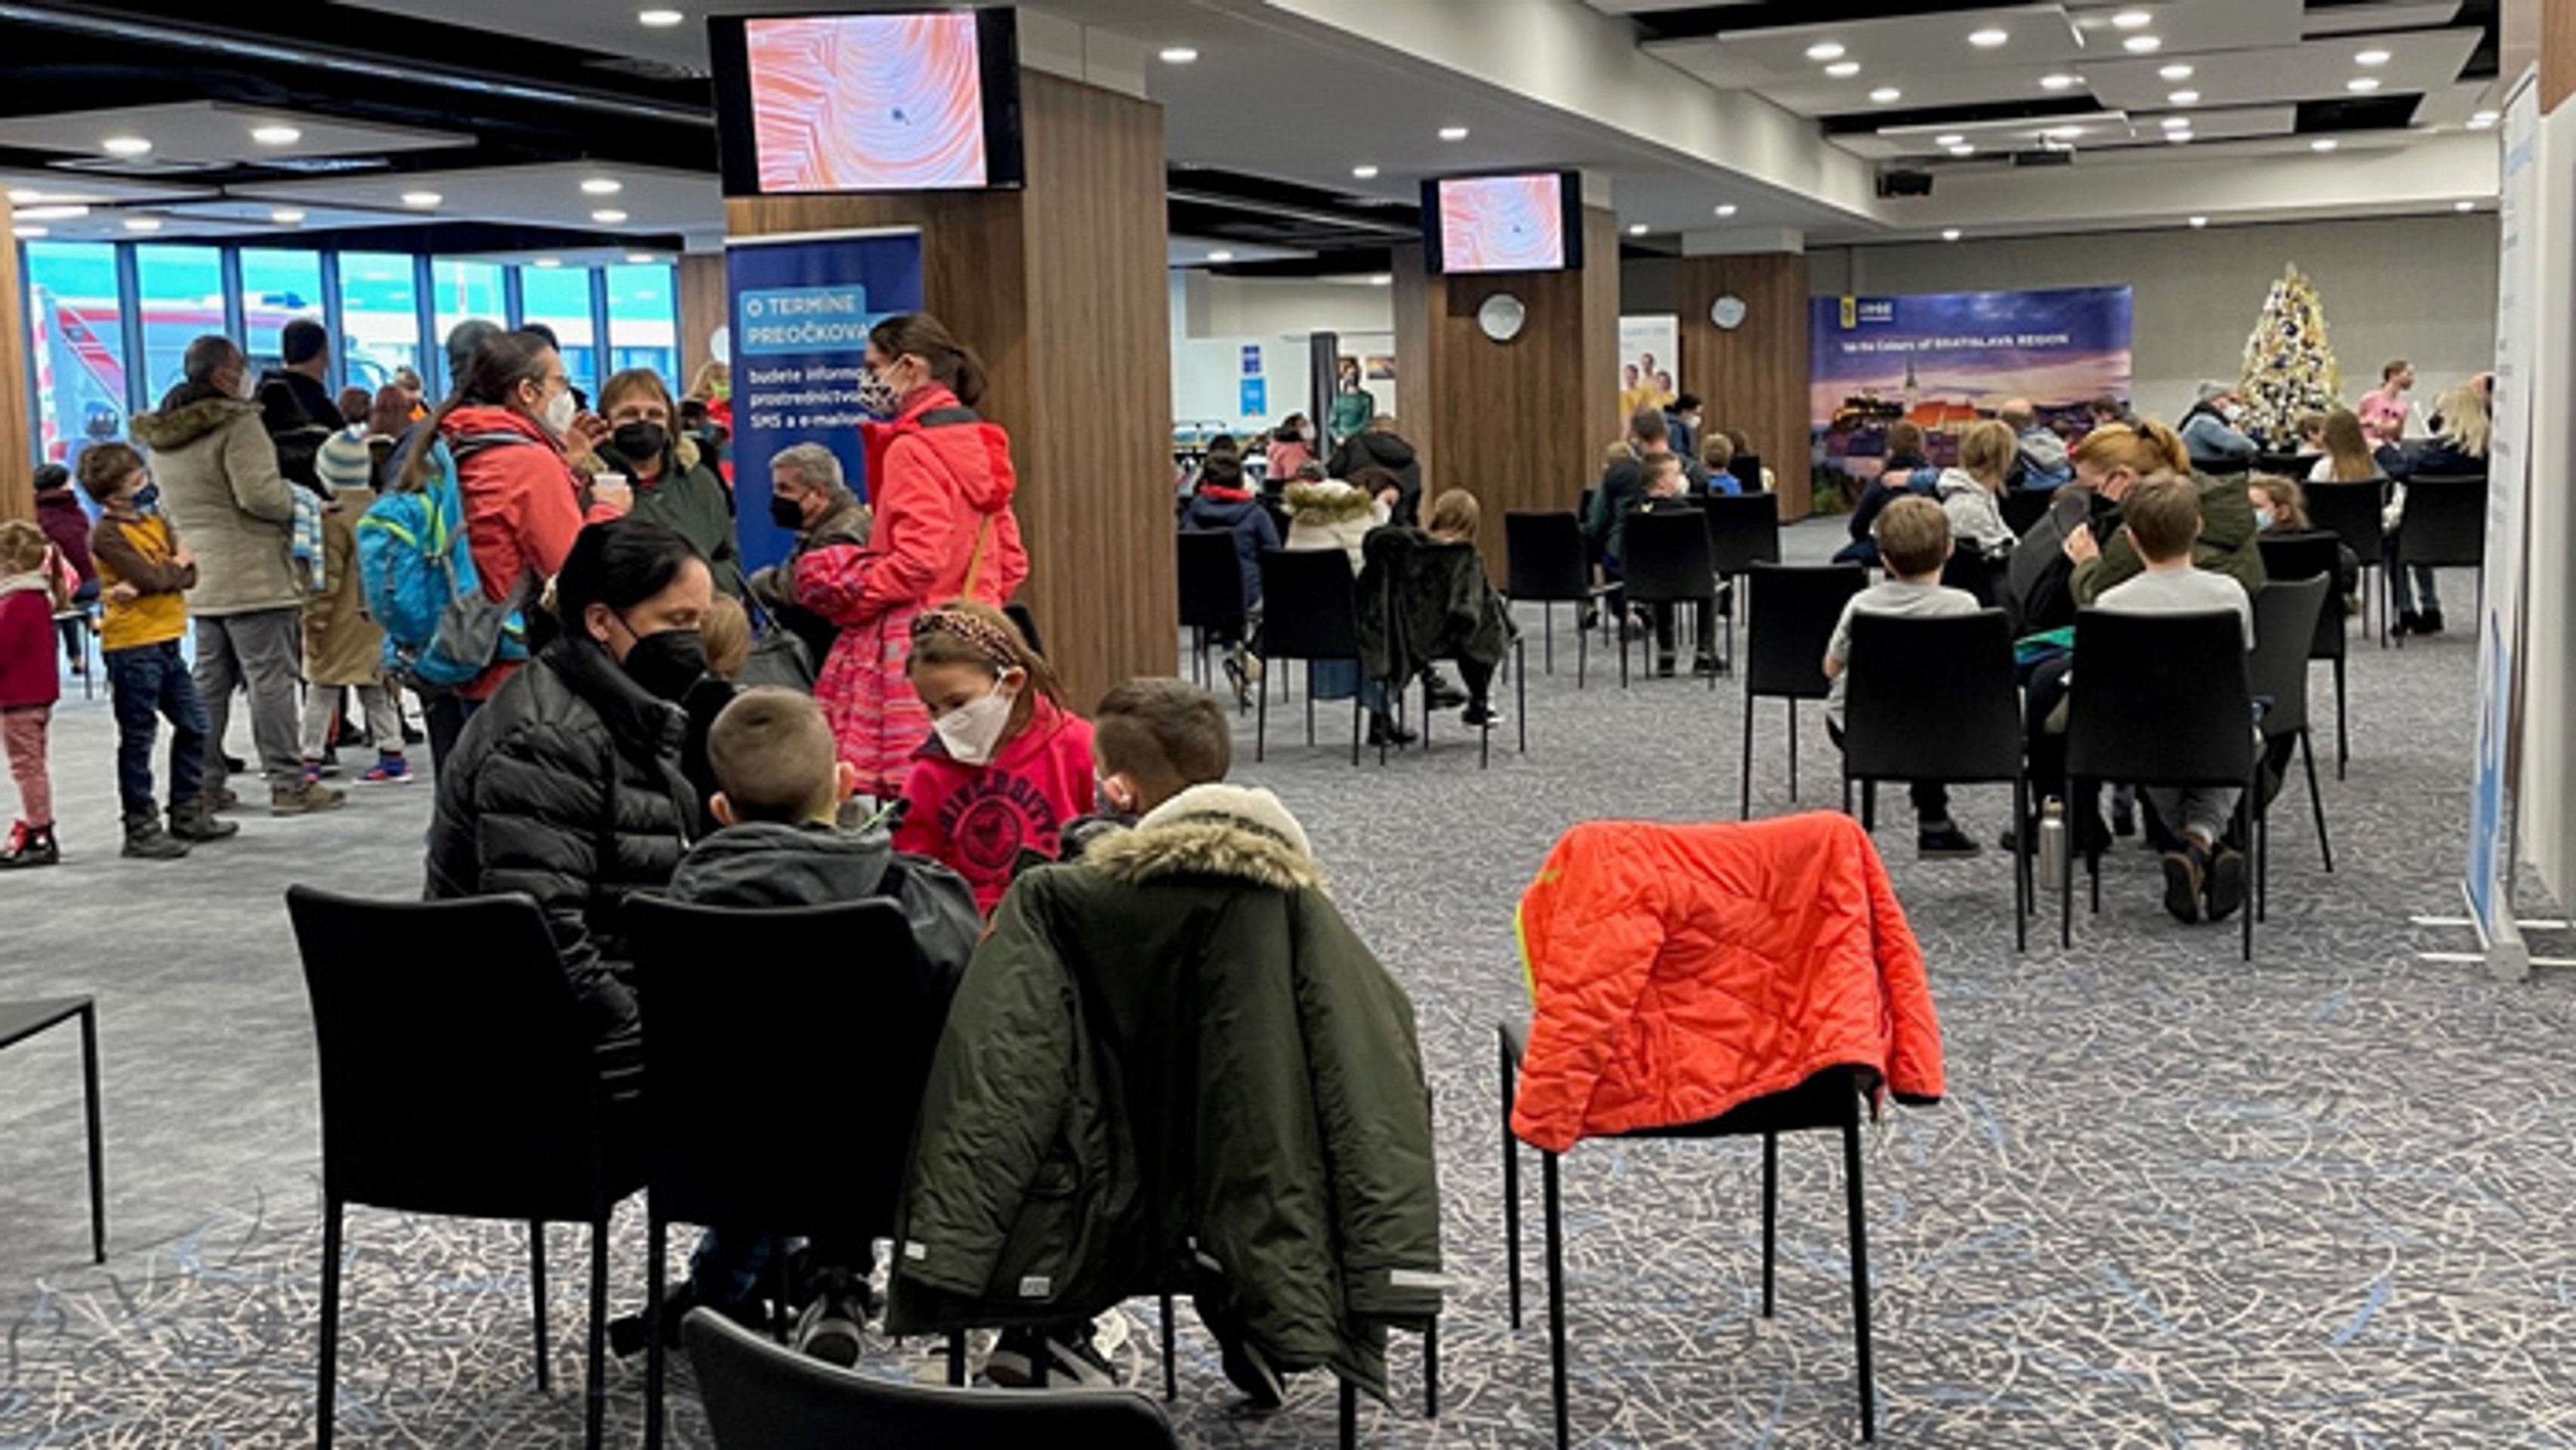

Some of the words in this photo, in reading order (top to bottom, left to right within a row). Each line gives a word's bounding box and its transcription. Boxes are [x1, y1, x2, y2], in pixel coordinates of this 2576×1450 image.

[747, 298, 764, 316] O
[768, 292, 856, 314] TERMÍNE
[748, 368, 801, 384] budete
[750, 413, 781, 428] SMS
[786, 416, 796, 428] a
